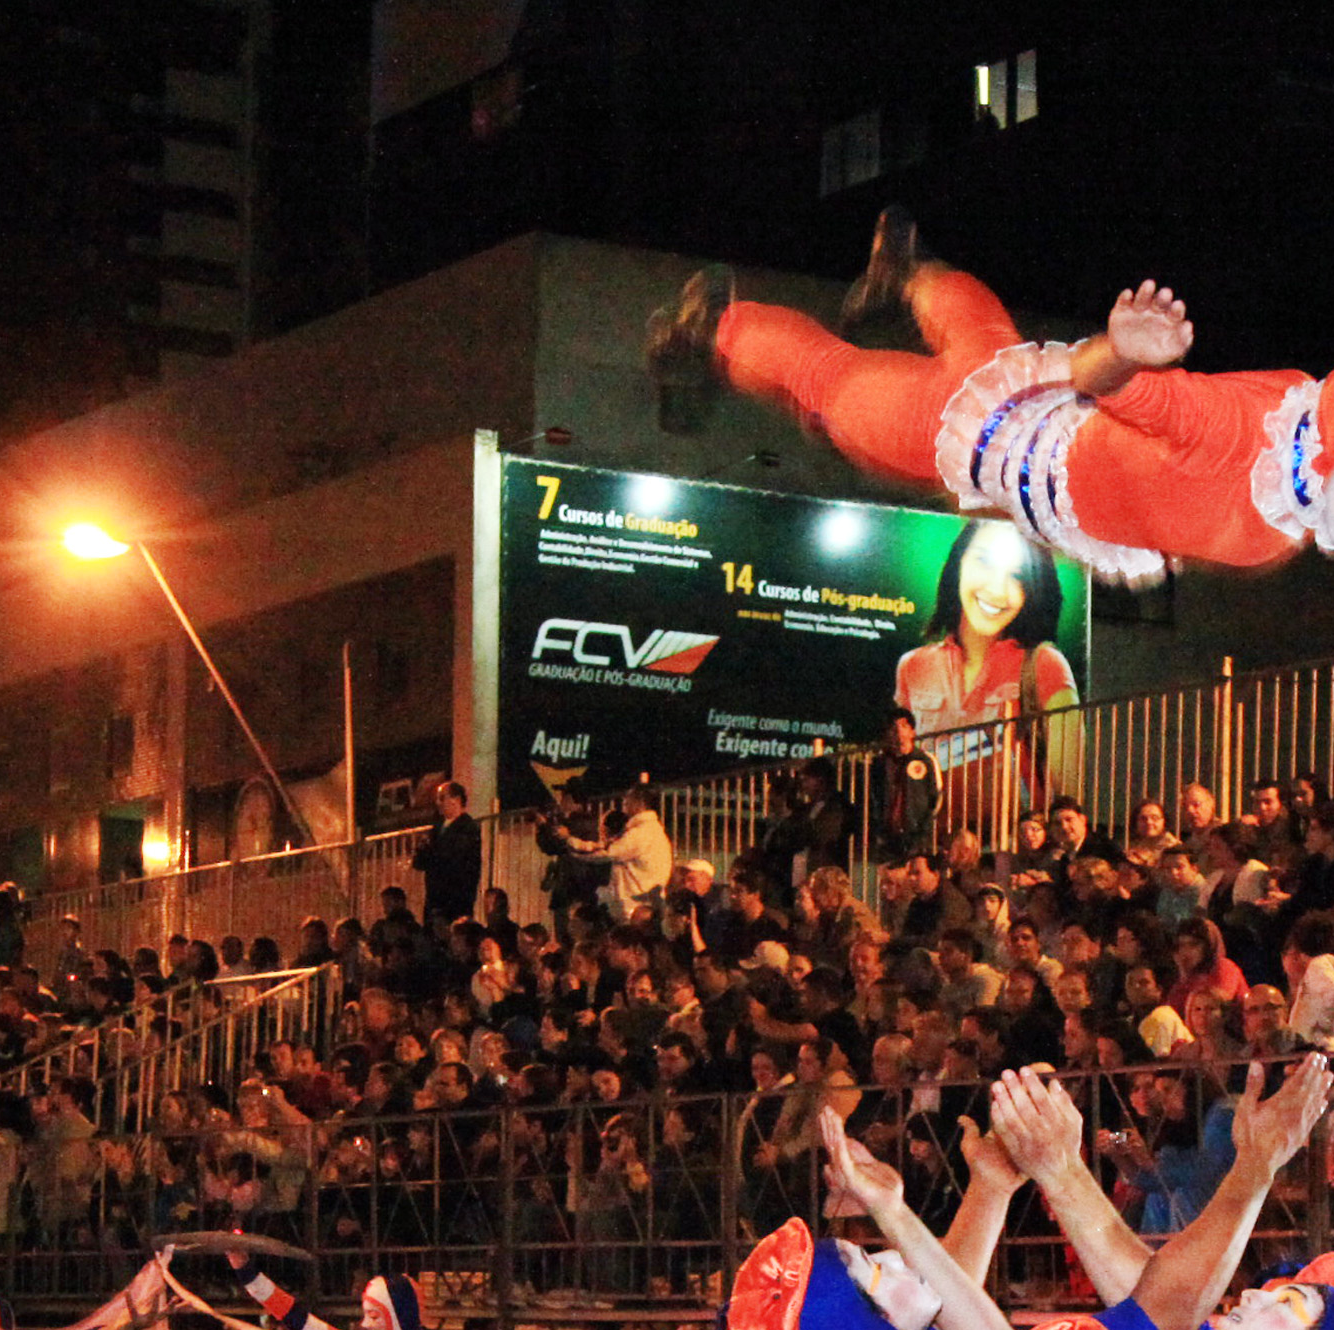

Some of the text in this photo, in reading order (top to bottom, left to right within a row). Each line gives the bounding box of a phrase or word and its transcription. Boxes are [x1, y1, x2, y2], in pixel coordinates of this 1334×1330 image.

[536, 475, 699, 539] 7 Cursos de Graduação
[720, 561, 915, 617] 14 Cursos de Pós-graduação
[531, 617, 664, 669] FCV
[528, 662, 593, 684] GRADUAÇÃO
[603, 670, 692, 694] PÓS-GRADUAÇÃO
[707, 708, 757, 731] Exigente
[531, 730, 591, 764] Aqui!
[715, 731, 787, 759] Exigente
